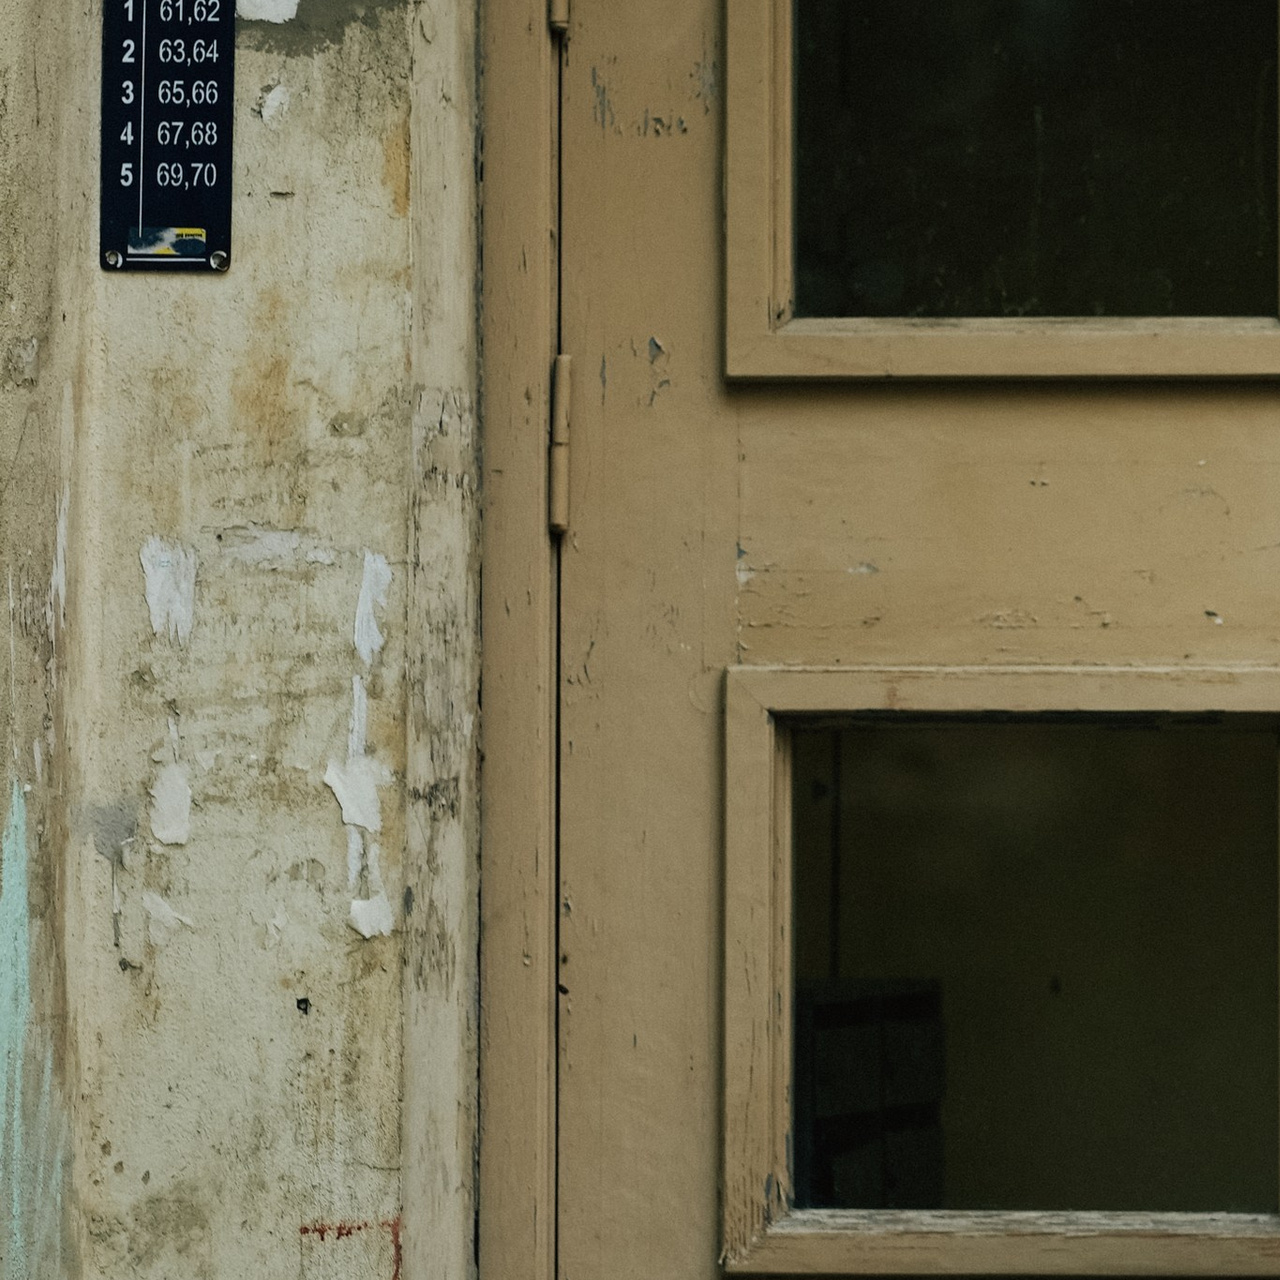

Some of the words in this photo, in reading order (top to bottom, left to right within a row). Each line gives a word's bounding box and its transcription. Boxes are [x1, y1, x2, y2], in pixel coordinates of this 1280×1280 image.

[122, 39, 134, 62] 2
[159, 39, 218, 66] 63,64
[122, 81, 134, 104] 3
[159, 80, 218, 107] 65,66
[120, 122, 133, 145] 4
[158, 122, 217, 148] 67,68
[121, 163, 133, 186] 5
[157, 163, 216, 190] 69,70
